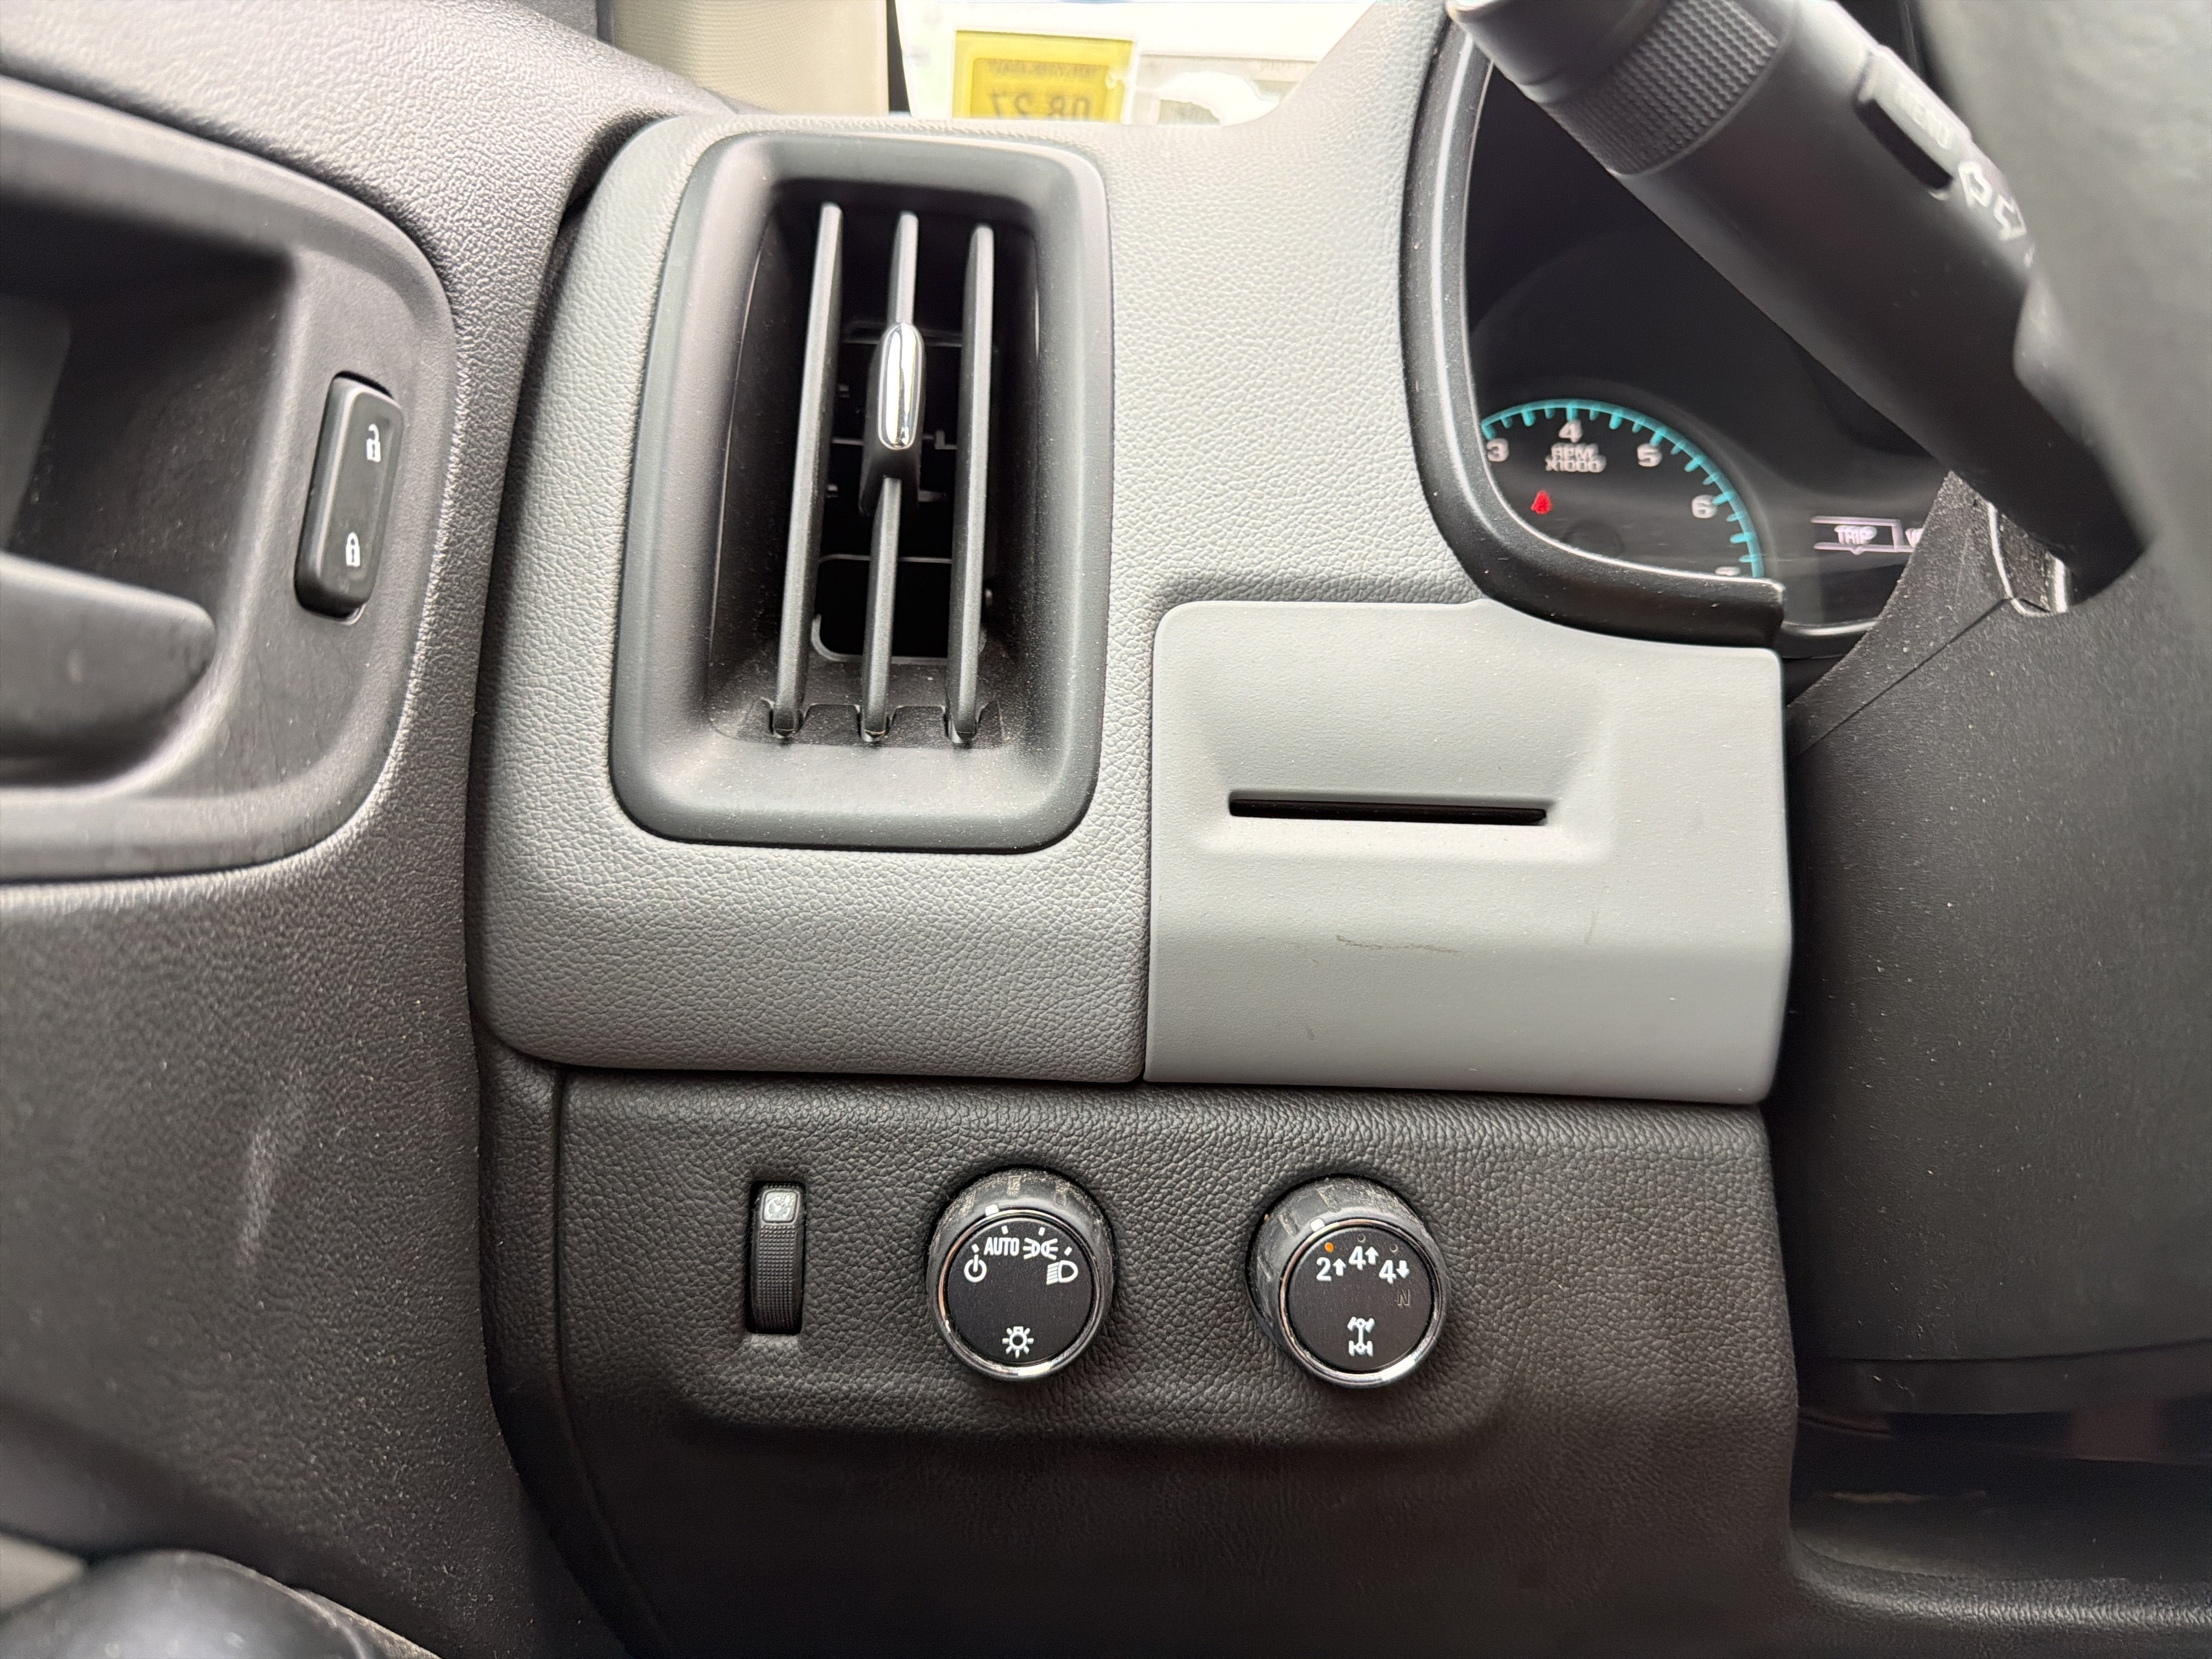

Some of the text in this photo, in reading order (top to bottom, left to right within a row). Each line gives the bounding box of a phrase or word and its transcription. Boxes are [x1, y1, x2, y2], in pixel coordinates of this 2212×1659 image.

[1559, 420, 1583, 443] 4
[1486, 438, 1509, 462] 3
[1551, 443, 1599, 461] RPM
[1637, 443, 1662, 467] 5
[1691, 494, 1718, 518] 6
[1834, 525, 1877, 544] TRIP
[984, 1237, 1020, 1256] AUTO
[1348, 1246, 1366, 1270] 4
[1316, 1257, 1332, 1282] 2
[1378, 1260, 1397, 1284] 4
[1397, 1289, 1410, 1306] N
